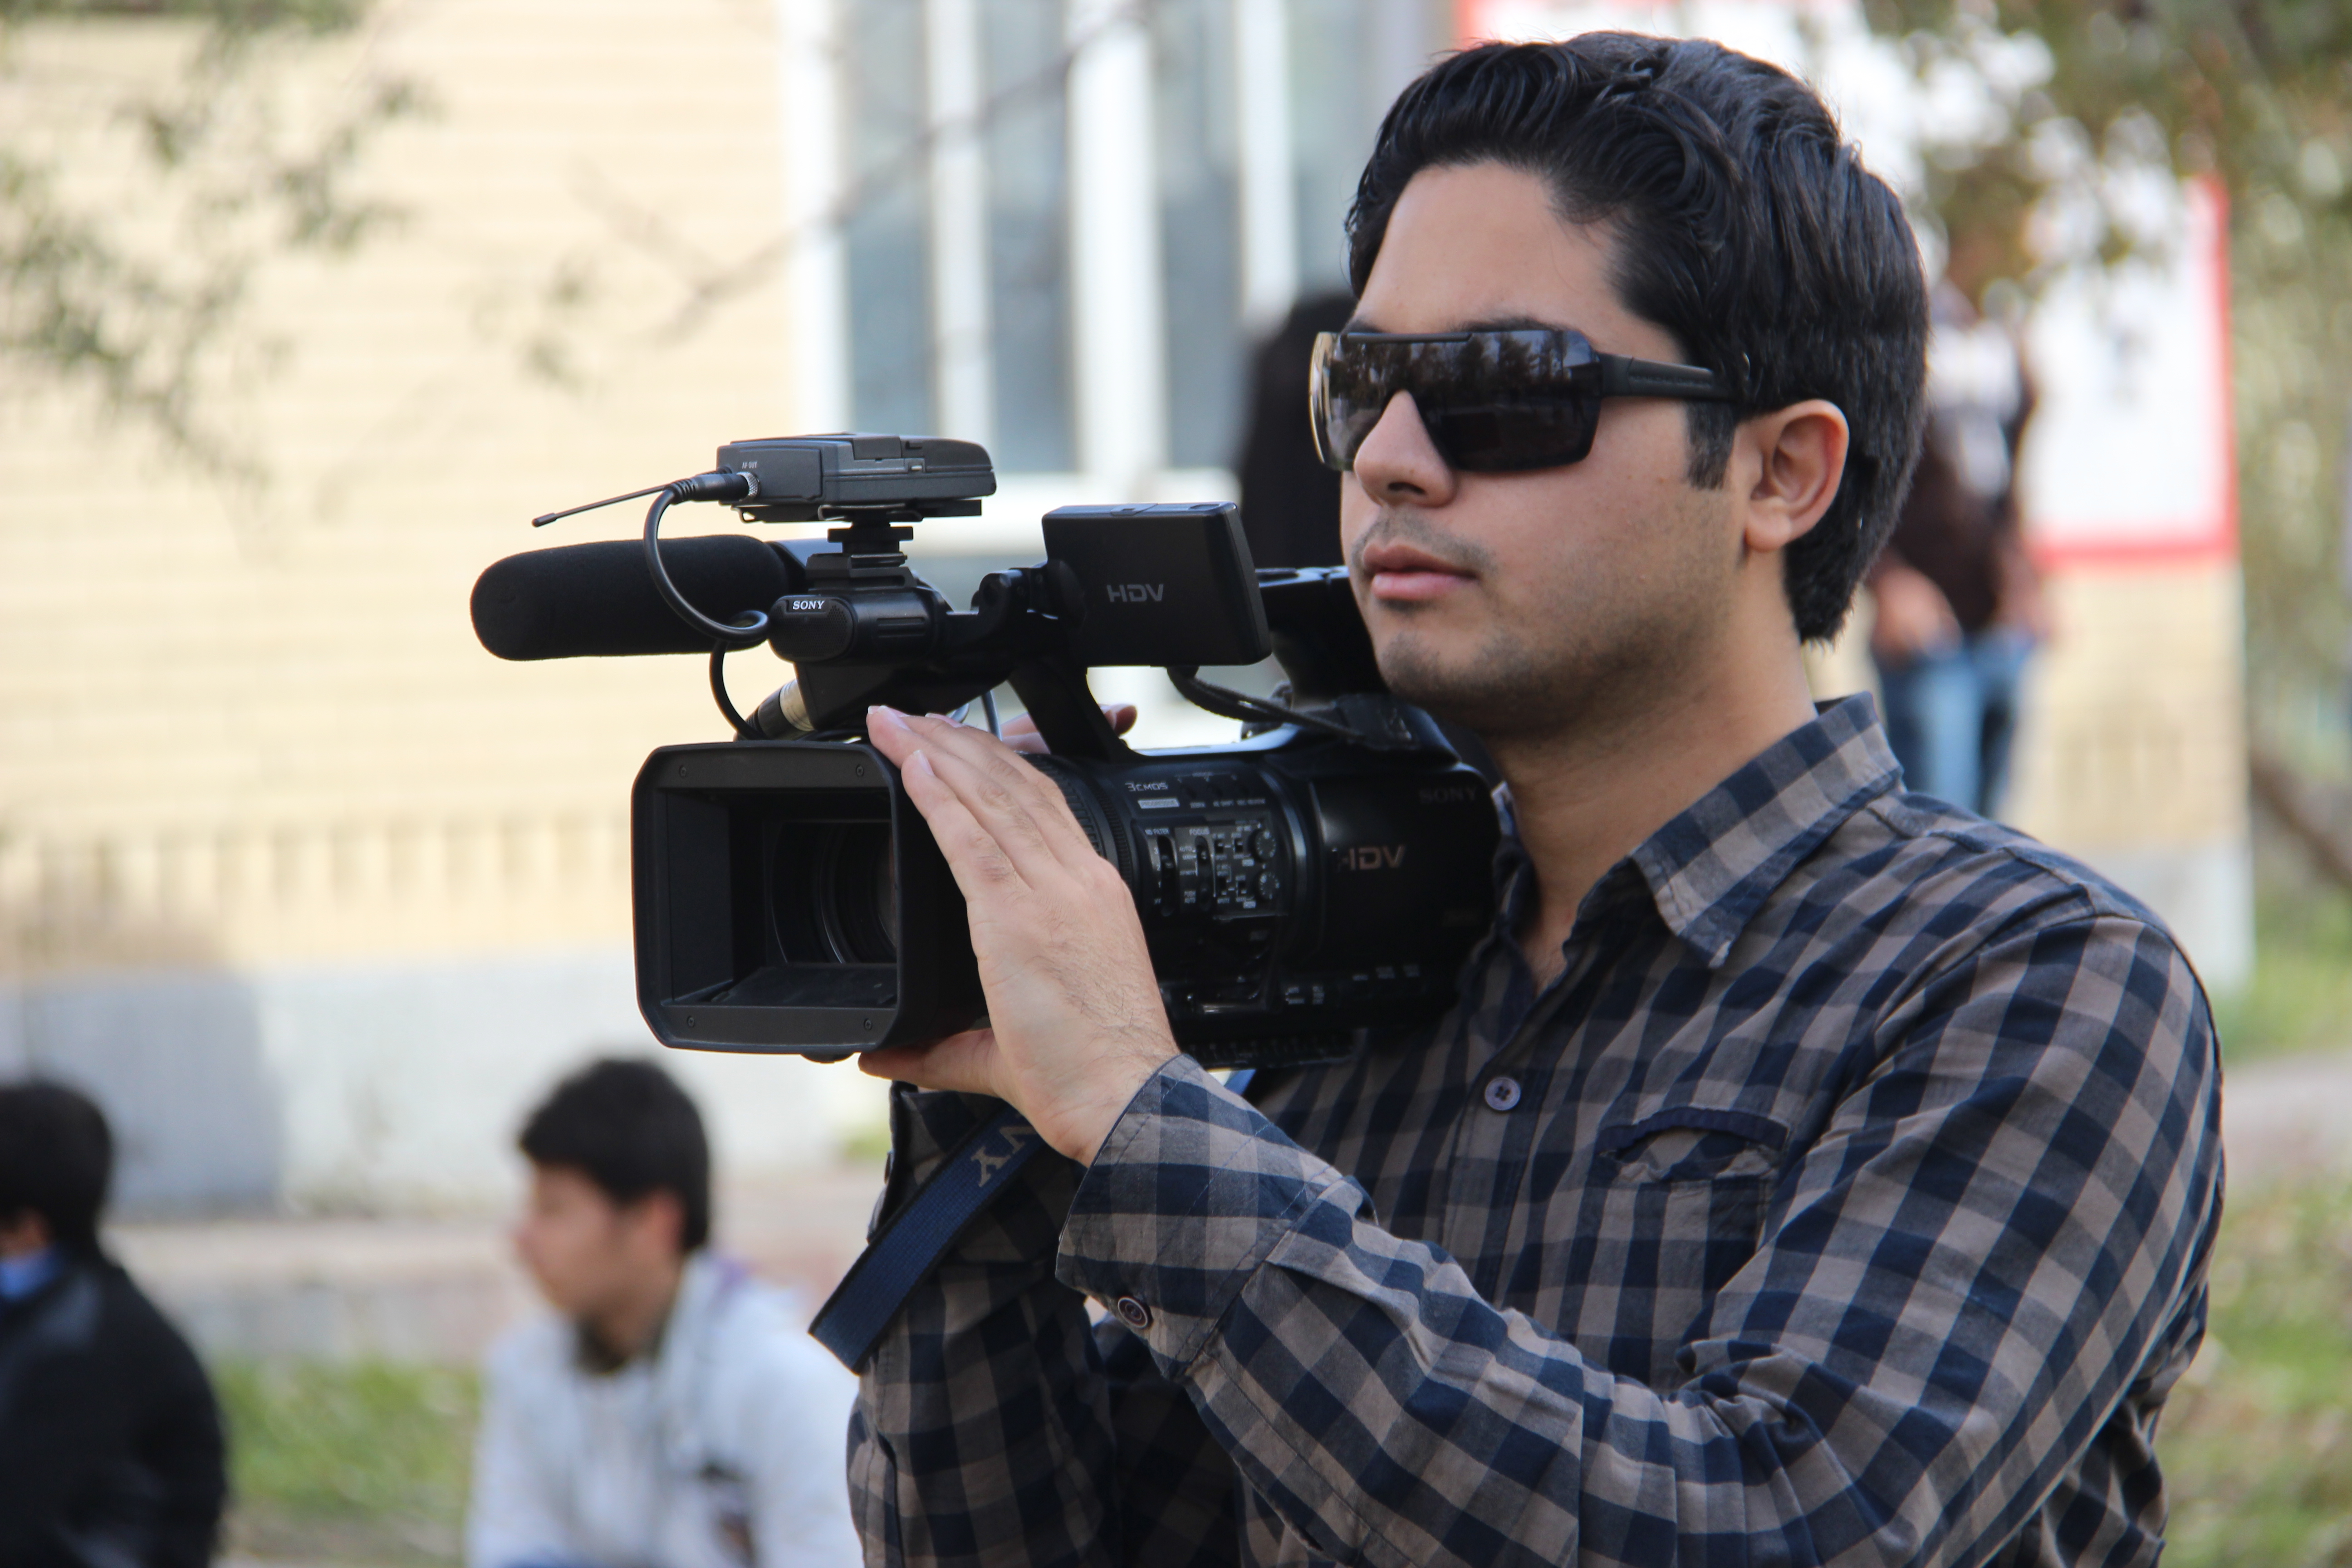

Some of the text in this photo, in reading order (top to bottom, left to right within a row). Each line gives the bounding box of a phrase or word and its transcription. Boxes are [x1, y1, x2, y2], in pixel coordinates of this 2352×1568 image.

[1106, 583, 1164, 603] HDV
[793, 600, 825, 610] SONY
[1418, 786, 1477, 804] SONY
[1335, 845, 1406, 872] HDV
